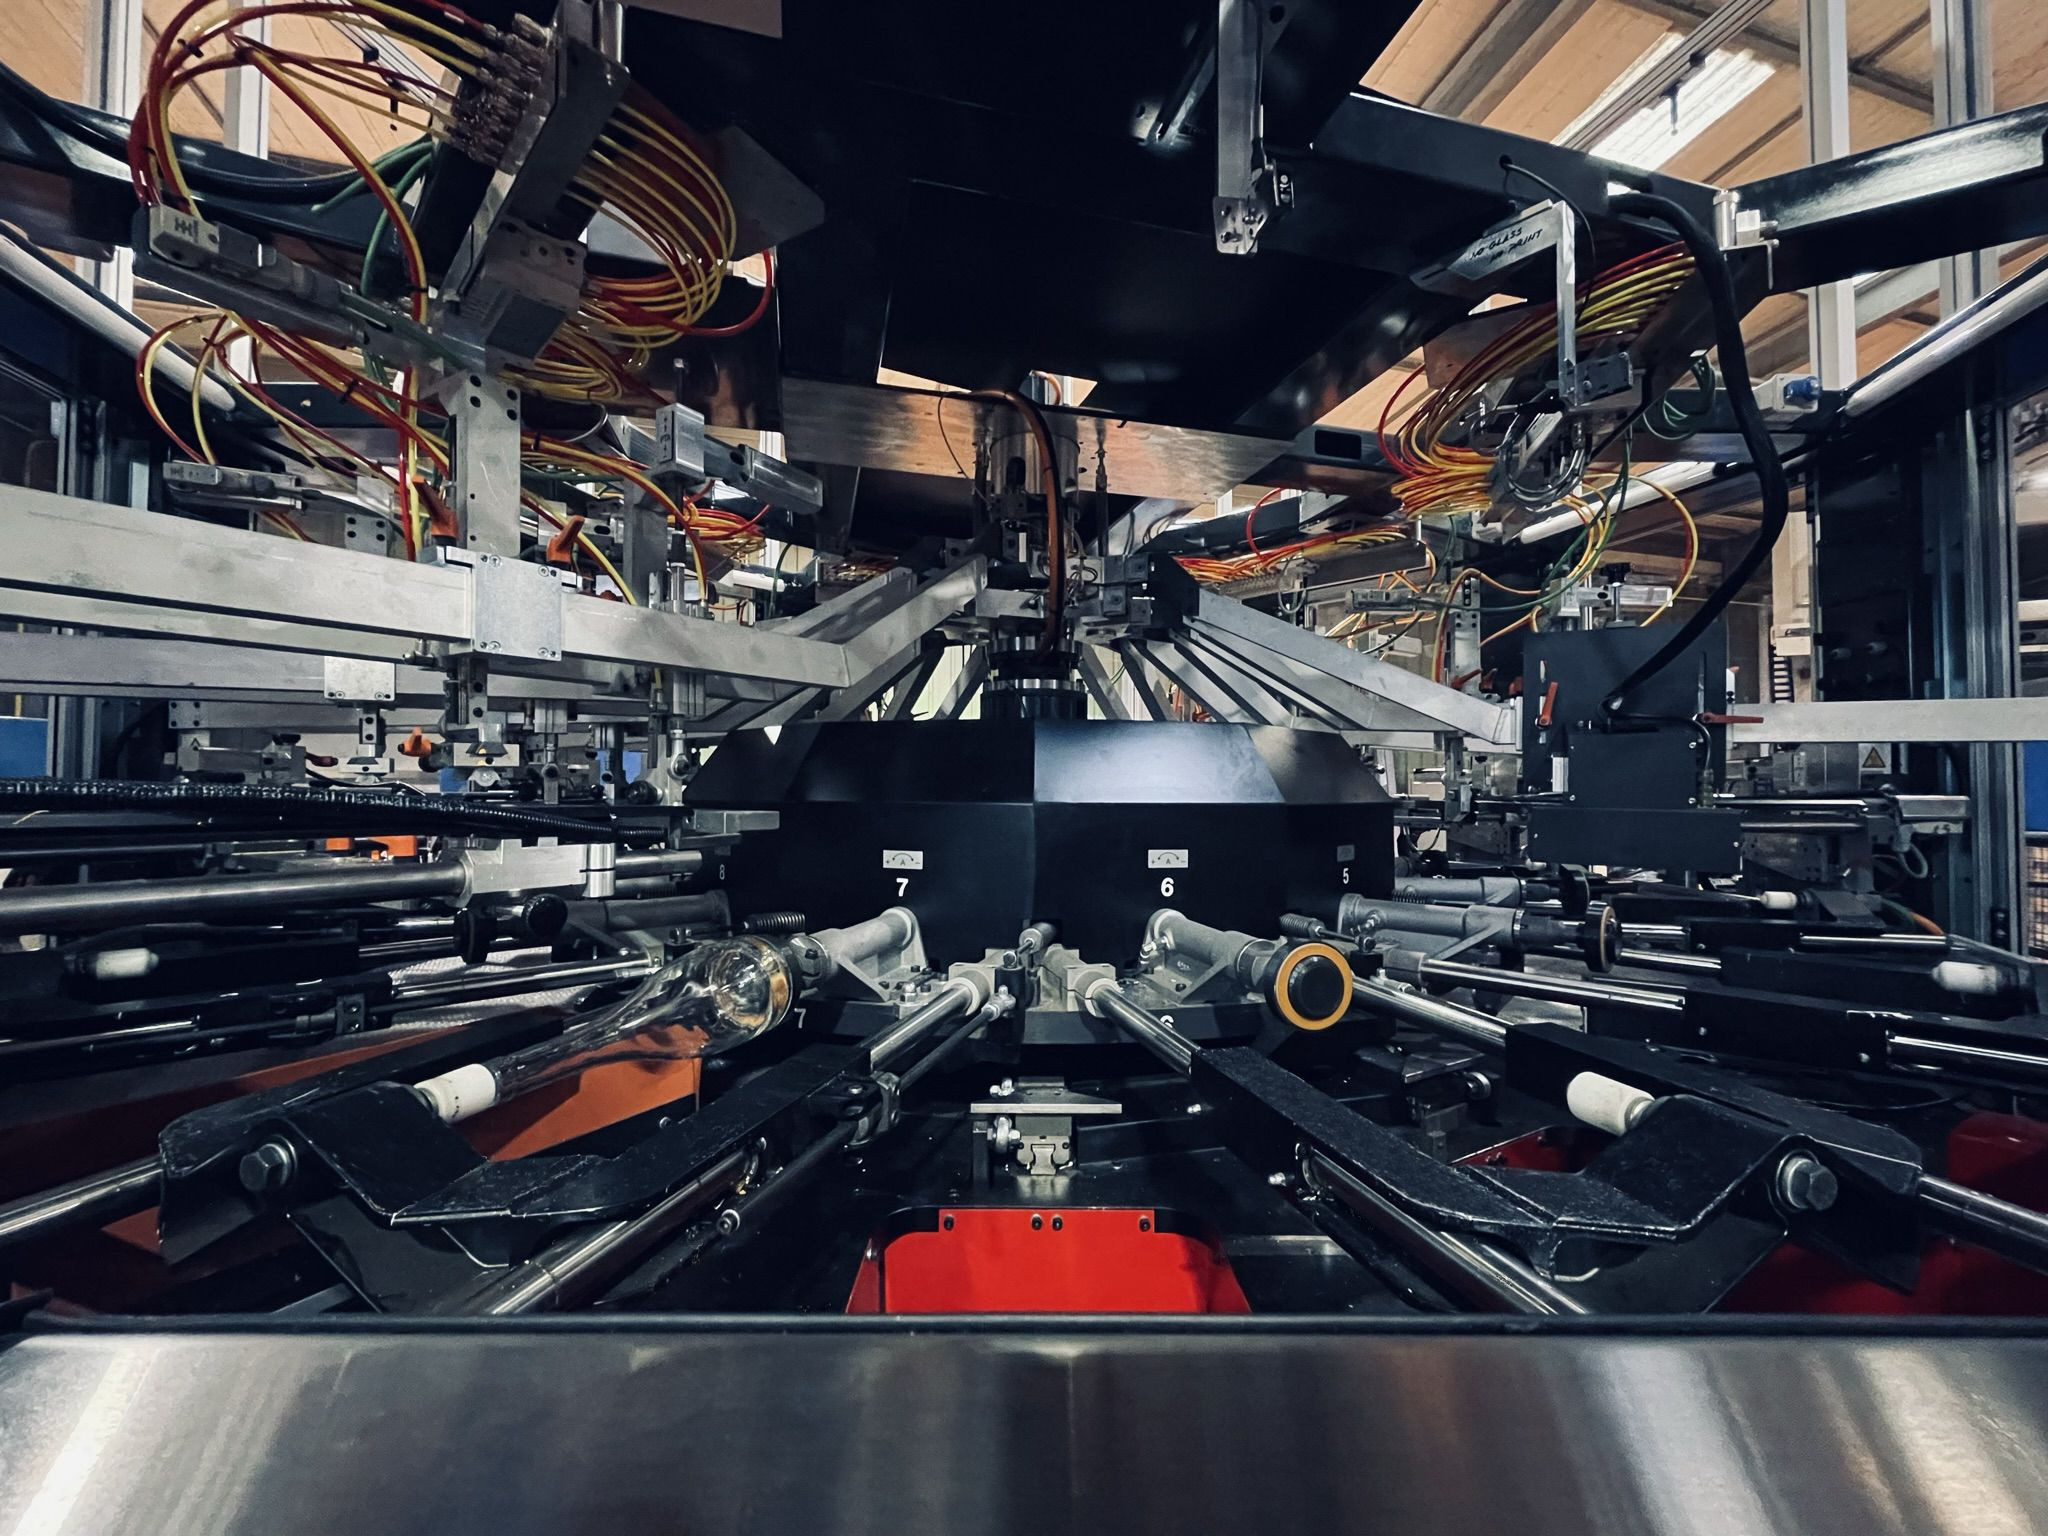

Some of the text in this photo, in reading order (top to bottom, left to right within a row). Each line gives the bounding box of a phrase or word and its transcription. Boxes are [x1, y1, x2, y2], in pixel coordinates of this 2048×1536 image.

[1470, 227, 1522, 260] NO GLASS
[1508, 229, 1543, 253] PRINT
[719, 864, 725, 880] 8
[1343, 867, 1350, 884] 5
[896, 878, 909, 897] 7
[1160, 877, 1175, 897] 6
[794, 1008, 806, 1029] 7
